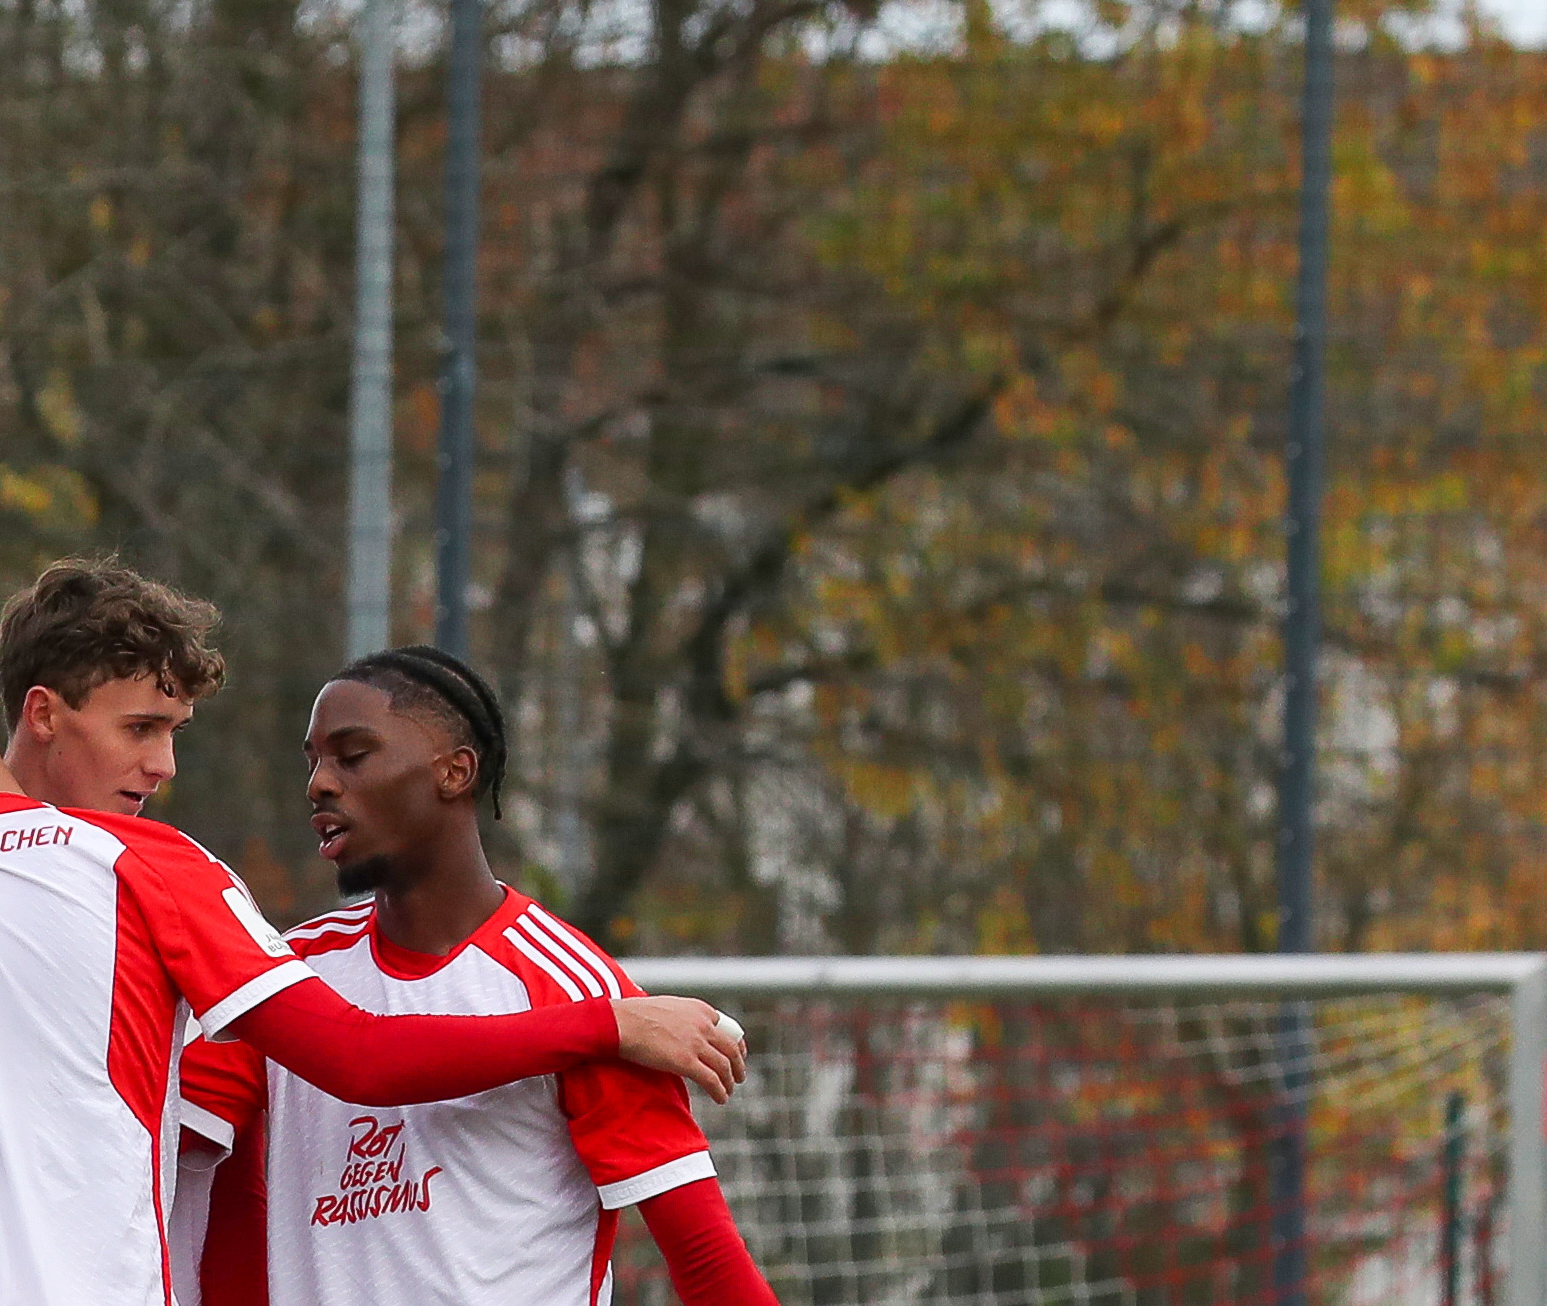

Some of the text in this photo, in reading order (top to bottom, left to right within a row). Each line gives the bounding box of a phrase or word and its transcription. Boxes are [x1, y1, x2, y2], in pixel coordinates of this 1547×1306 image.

[348, 1116, 406, 1162] ROT
[340, 1143, 405, 1190] GEGEN
[311, 1166, 444, 1227] RASSISMUS
